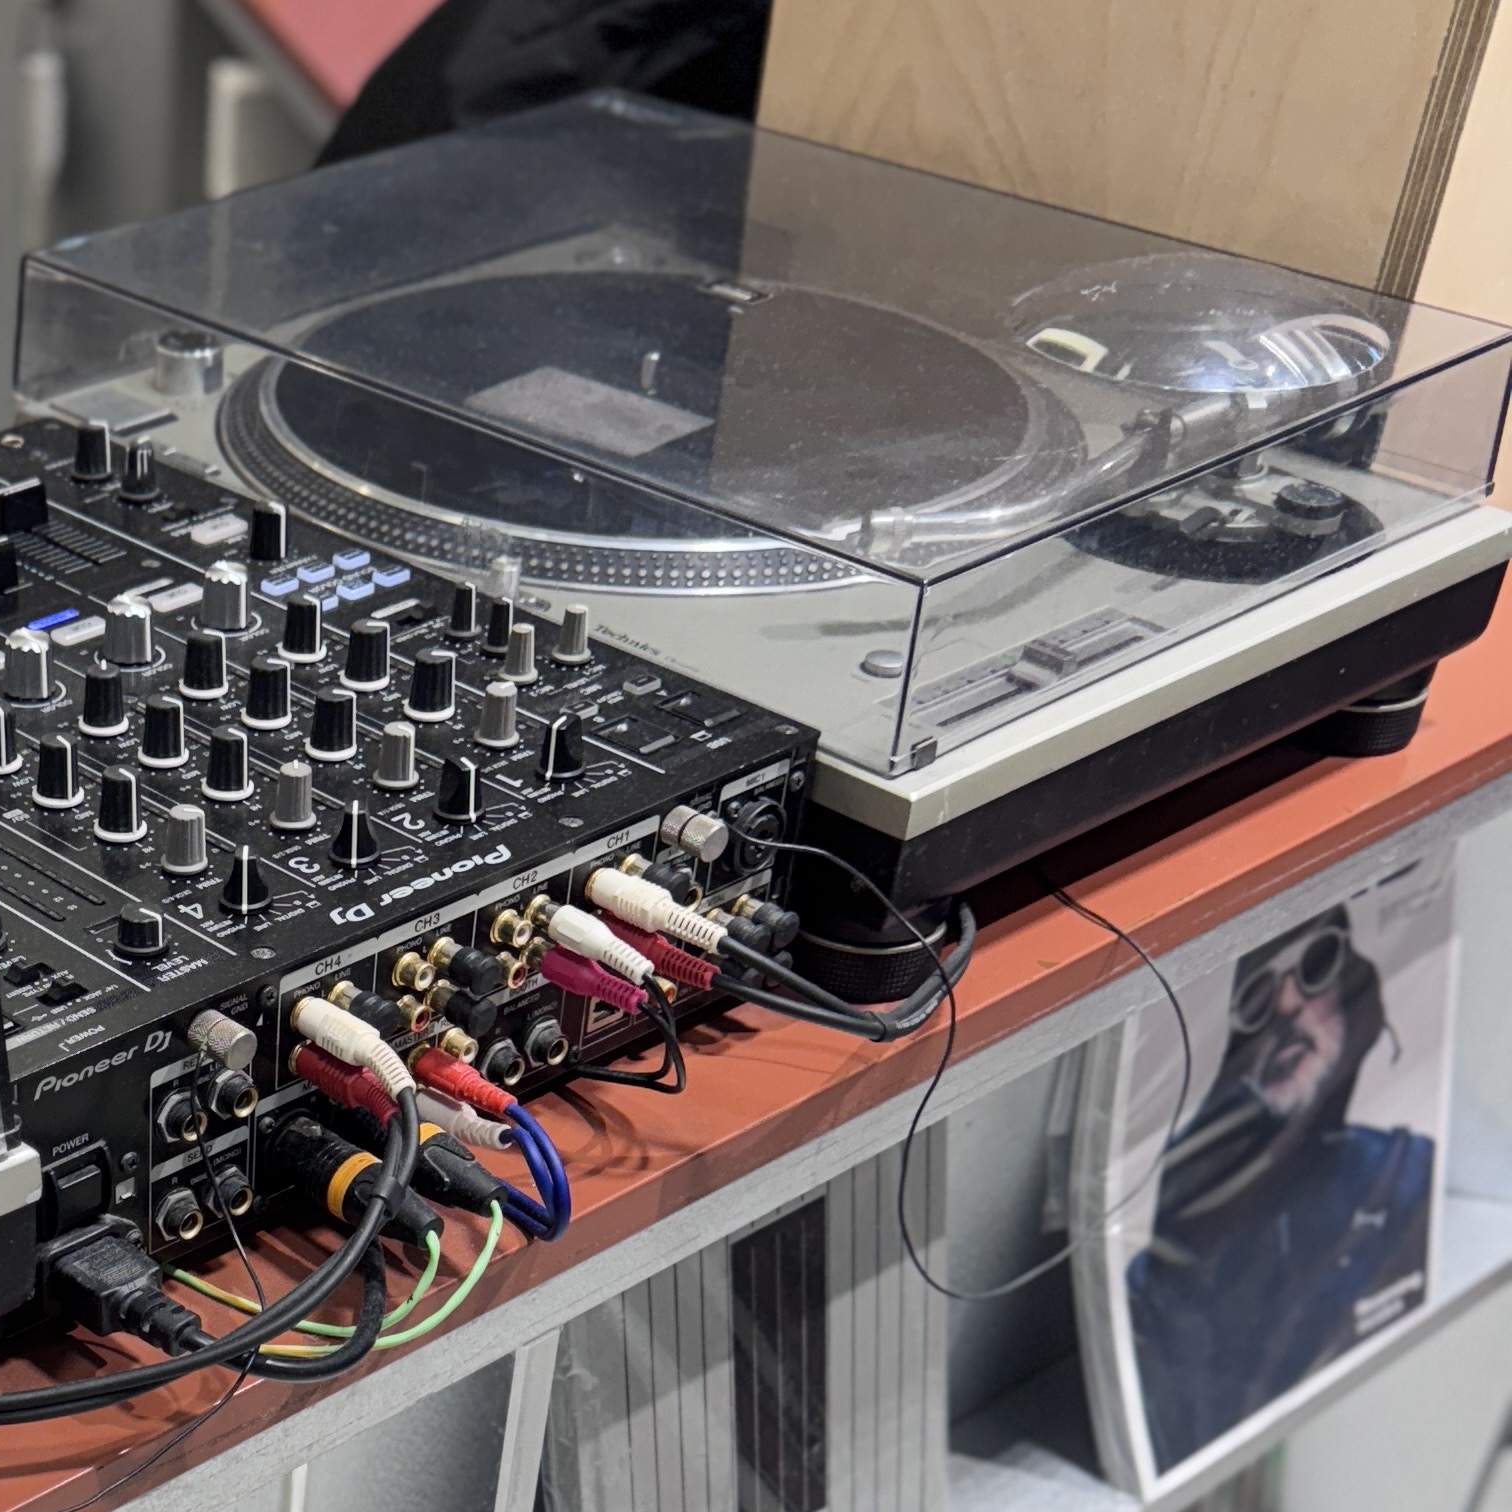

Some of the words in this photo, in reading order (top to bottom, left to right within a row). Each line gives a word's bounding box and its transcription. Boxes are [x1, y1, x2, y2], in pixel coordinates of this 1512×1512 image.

[11, 776, 35, 787] LOW
[494, 773, 524, 788] 1
[391, 812, 426, 830] 2
[607, 831, 630, 849] CH1
[287, 856, 321, 874] 3
[195, 876, 224, 891] TRIM
[379, 844, 512, 907] Pioneer
[512, 871, 538, 890] CH2
[177, 902, 205, 919] 4
[329, 902, 375, 925] DJ
[216, 923, 247, 938] PHONO
[253, 920, 273, 933] LINE
[414, 912, 441, 934] CH3
[395, 936, 424, 954] PHONO
[150, 954, 190, 973] LEVEL
[156, 958, 209, 983] MASTER
[314, 956, 342, 977] CH4
[293, 980, 321, 999] PHONO
[63, 1024, 106, 1046] POWER
[33, 1046, 139, 1101] Pioneer
[143, 1030, 173, 1053] DJ
[51, 1133, 90, 1157] POWER
[187, 1143, 214, 1163] SED
